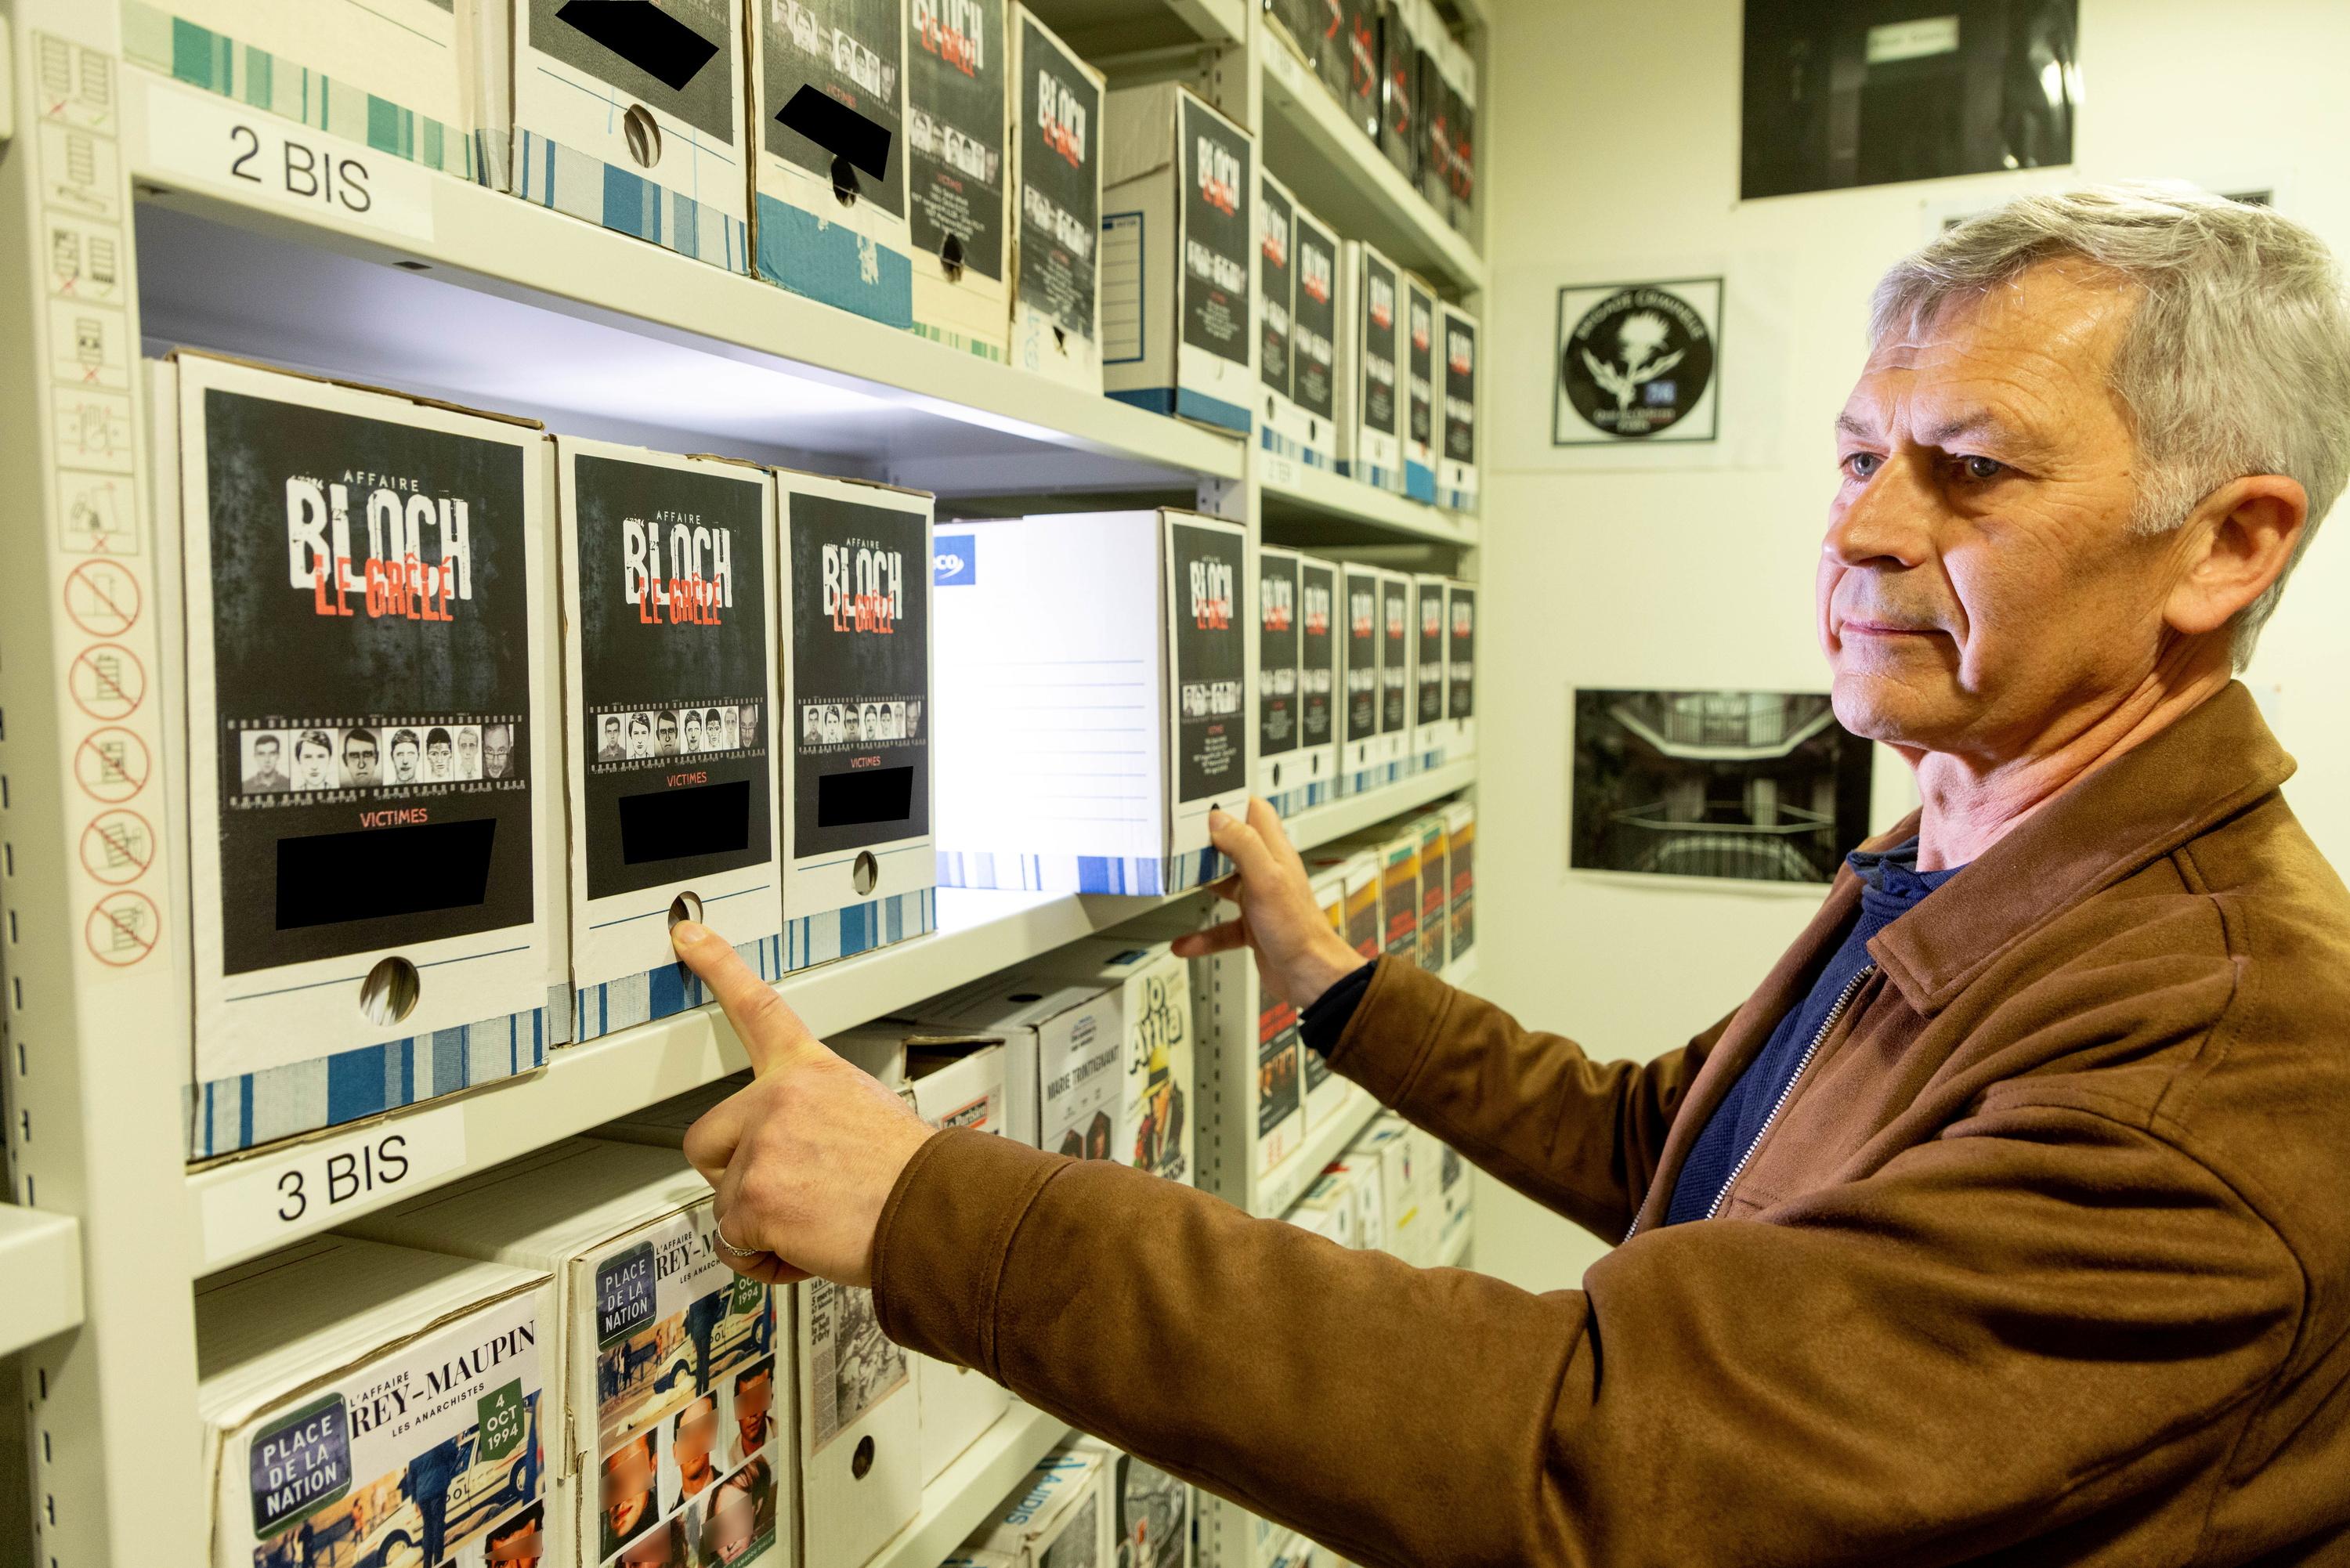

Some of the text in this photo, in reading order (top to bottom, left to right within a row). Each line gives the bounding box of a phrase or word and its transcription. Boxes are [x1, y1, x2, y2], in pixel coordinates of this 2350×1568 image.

[230, 125, 372, 212] 2 BIS
[344, 469, 419, 492] AFFAIRE
[656, 510, 701, 525] AFFAIRE
[286, 476, 472, 600] BLOCH
[847, 537, 880, 549] AFFAIRE
[623, 520, 732, 608] BLOCH
[313, 552, 454, 621] LE GRÊLÉ
[639, 572, 721, 625] LE GRÊLÉ
[822, 545, 902, 620] BLOCH
[833, 593, 850, 632] LE
[667, 771, 707, 787] VICTIMES
[851, 756, 881, 768] VICTIMES
[360, 808, 428, 828] VICTIMES
[278, 1135, 409, 1222] 3 BIS
[656, 1232, 692, 1255] L'AFFAIRE
[656, 1230, 716, 1281] REY-M
[606, 1259, 645, 1292] PLACE
[680, 1259, 721, 1284] LES ANARCH
[607, 1282, 644, 1313] DE LA
[739, 1287, 758, 1305] 1994
[606, 1296, 648, 1333] NATION
[350, 1320, 536, 1440] REY-MAUPIN
[350, 1371, 410, 1407] L'AFFAIRE
[392, 1382, 485, 1437] LES ANARCHISTES
[486, 1405, 517, 1432] OCT
[496, 1394, 504, 1408] 4
[263, 1415, 333, 1467] PLACE
[487, 1422, 519, 1451] 1994
[269, 1444, 329, 1490] DE LA
[267, 1461, 337, 1517] NATION
